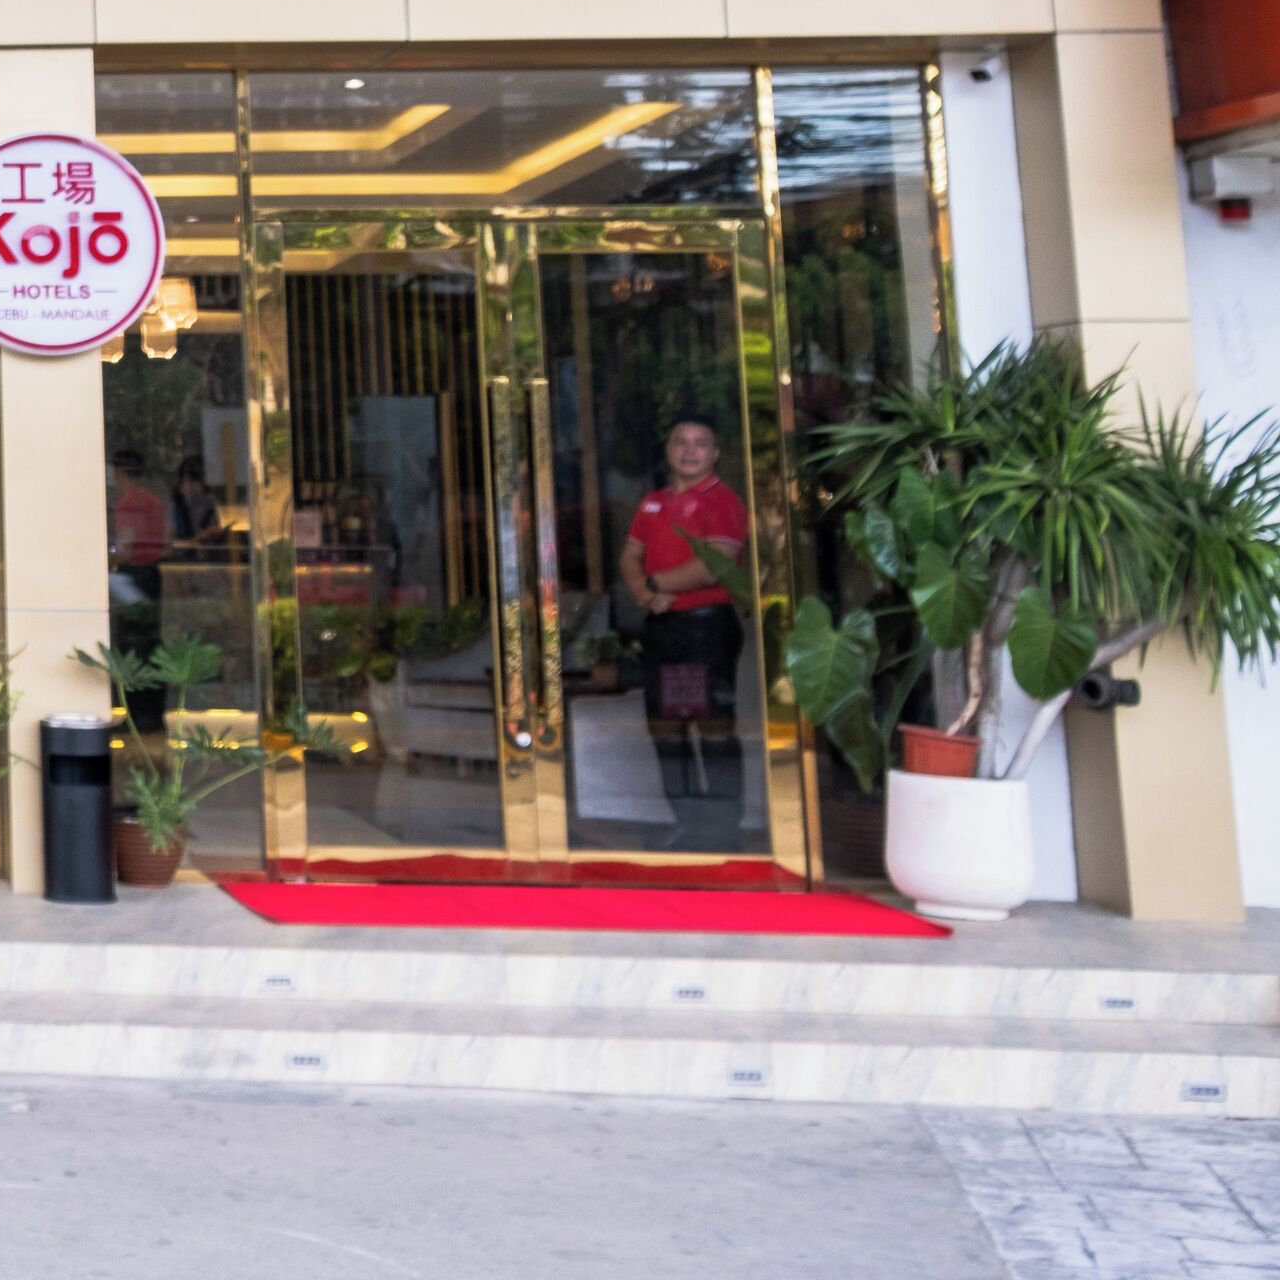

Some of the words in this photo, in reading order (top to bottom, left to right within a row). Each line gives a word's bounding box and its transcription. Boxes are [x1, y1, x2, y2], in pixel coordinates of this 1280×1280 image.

[0, 162, 96, 205] 工場
[12, 285, 92, 300] HOTELS
[40, 308, 111, 321] MANDAUE
